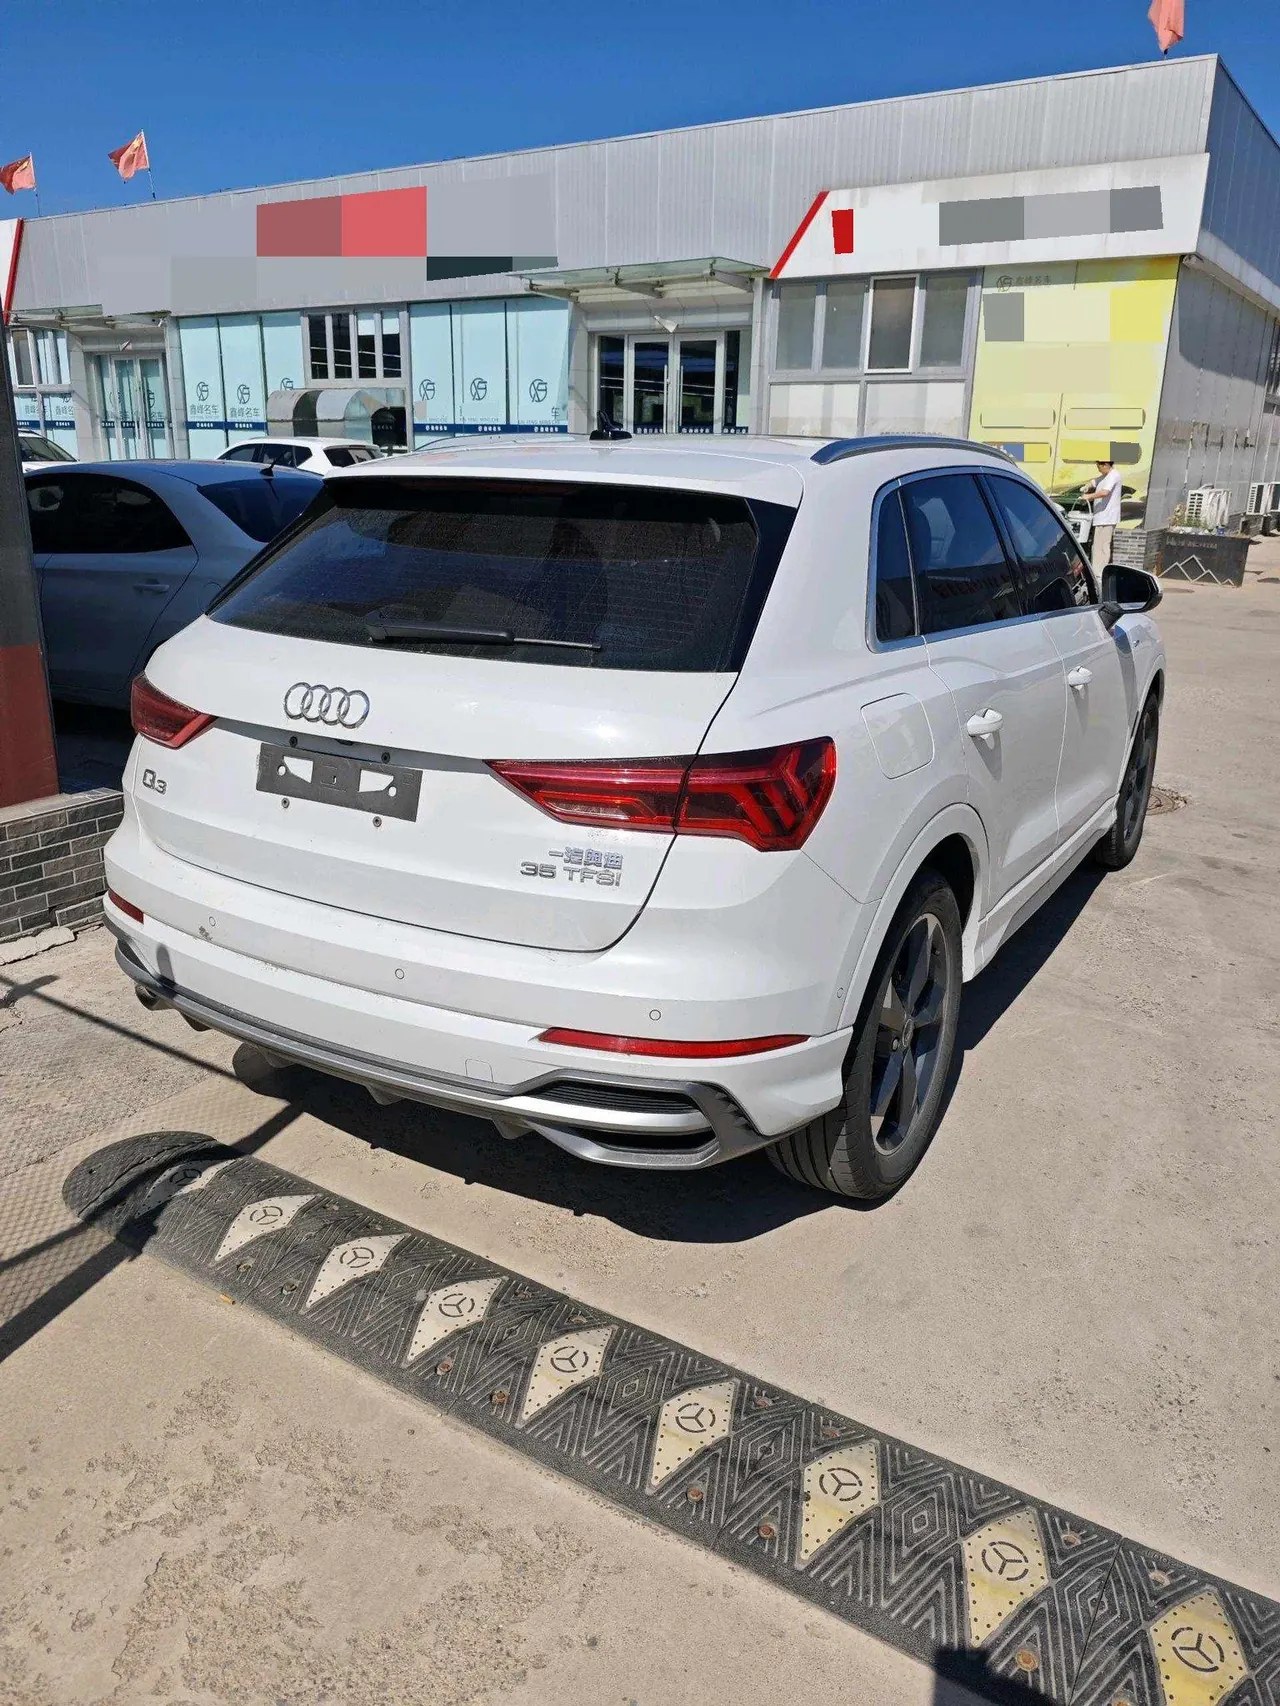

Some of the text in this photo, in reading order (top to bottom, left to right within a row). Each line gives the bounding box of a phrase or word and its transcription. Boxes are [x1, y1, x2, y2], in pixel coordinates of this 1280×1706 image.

[142, 768, 167, 795] Q3
[548, 846, 623, 870] 一汽奥迪
[520, 861, 622, 887] 35 TFSI
